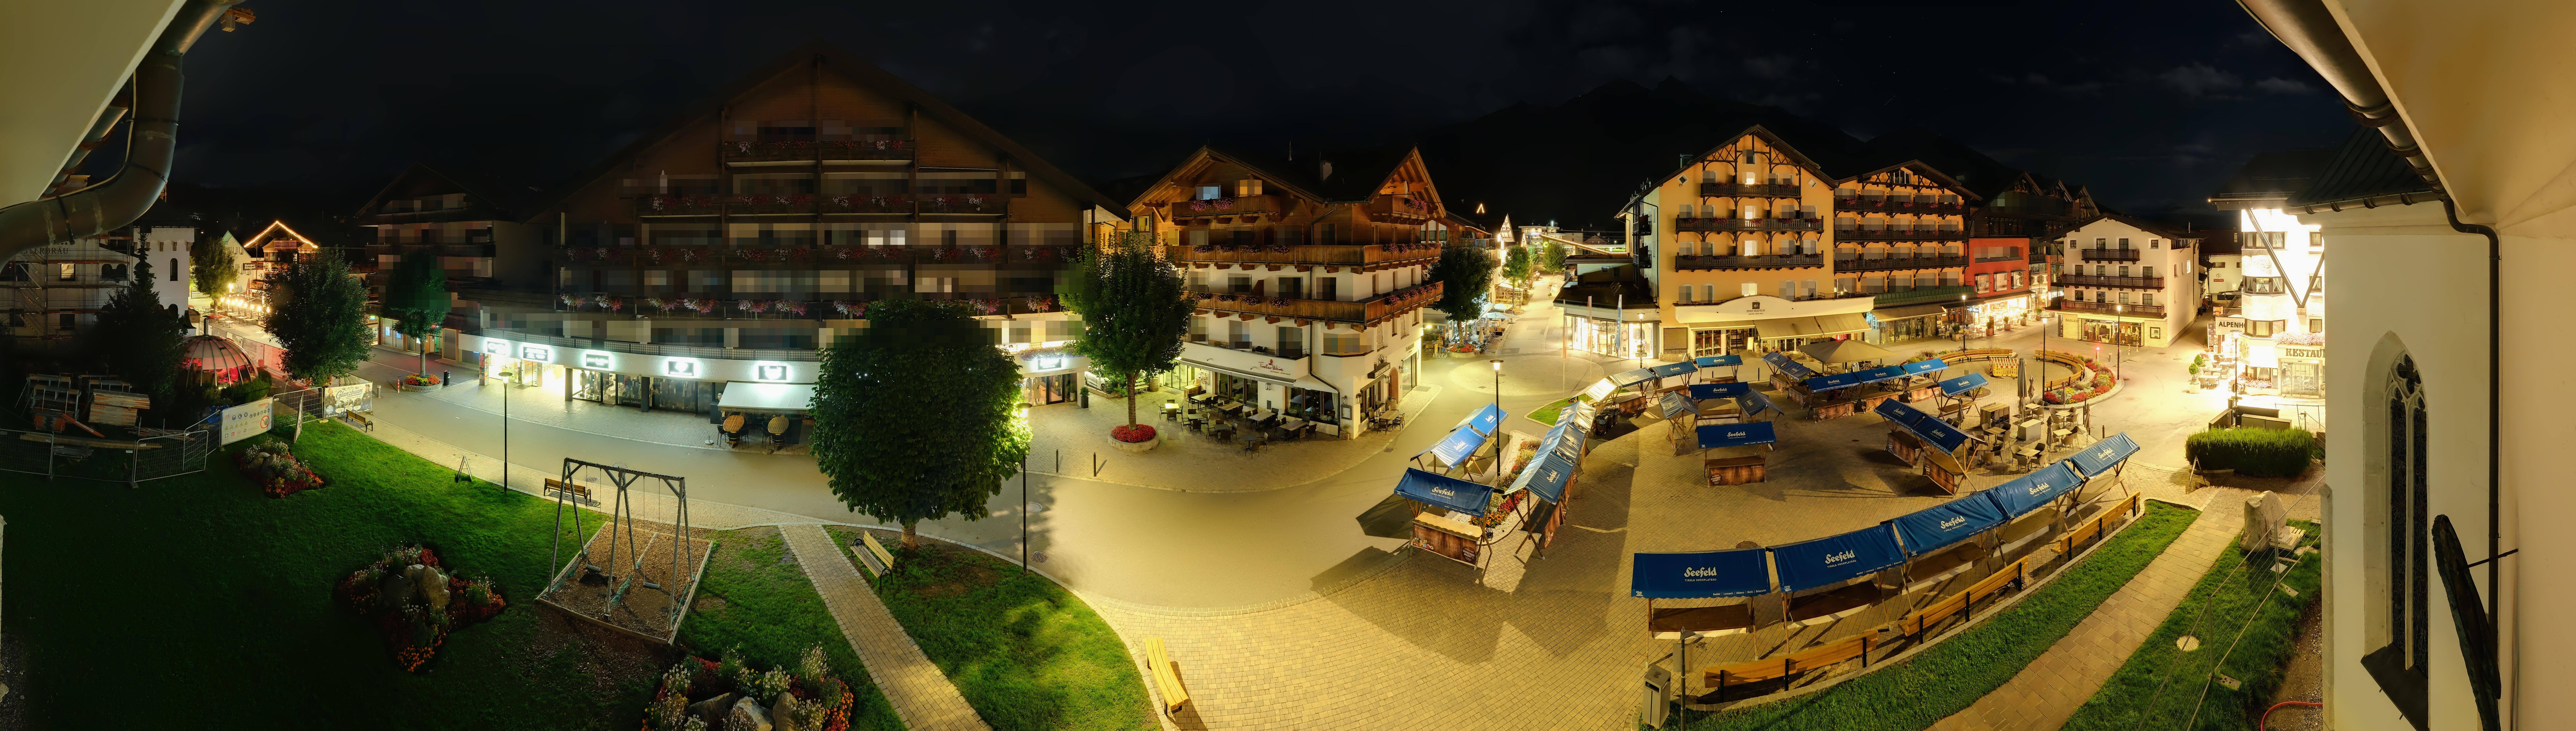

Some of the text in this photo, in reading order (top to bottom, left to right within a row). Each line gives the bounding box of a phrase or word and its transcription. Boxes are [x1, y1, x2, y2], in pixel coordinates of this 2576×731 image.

[1406, 343, 1414, 351] SAILER
[1375, 364, 1389, 377] RESTAURANT
[336, 388, 363, 401] Glanzbuam
[1932, 429, 1946, 438] Seefeld
[1453, 440, 1466, 450] Seefeld
[2098, 448, 2113, 458] Seefeld
[1546, 470, 1557, 482] Seefeld
[1432, 486, 1455, 496] Seefeld
[2029, 482, 2049, 495] Seefeld
[1941, 515, 1965, 529] Seefeld
[1825, 549, 1855, 564] Seefeld
[1684, 567, 1717, 577] Seefeld
